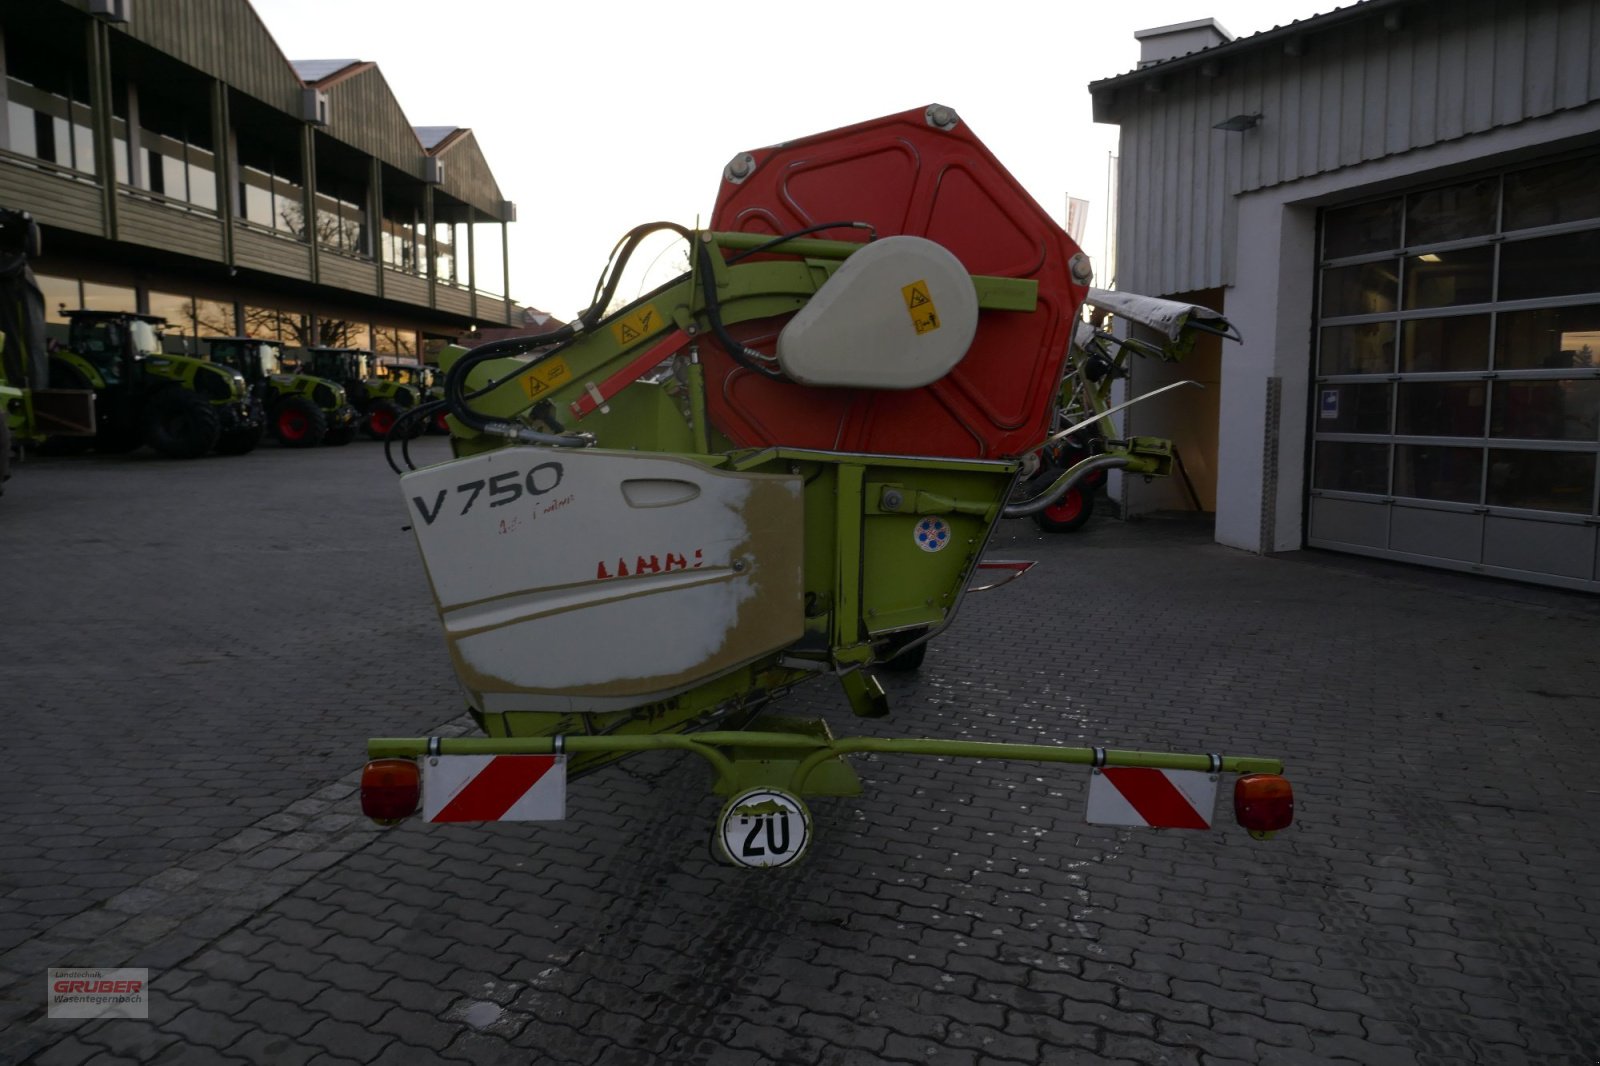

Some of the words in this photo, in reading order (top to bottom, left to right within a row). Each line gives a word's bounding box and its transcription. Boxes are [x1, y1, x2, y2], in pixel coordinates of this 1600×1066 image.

[412, 488, 448, 526] V
[457, 461, 565, 516] 750
[741, 811, 790, 857] 20
